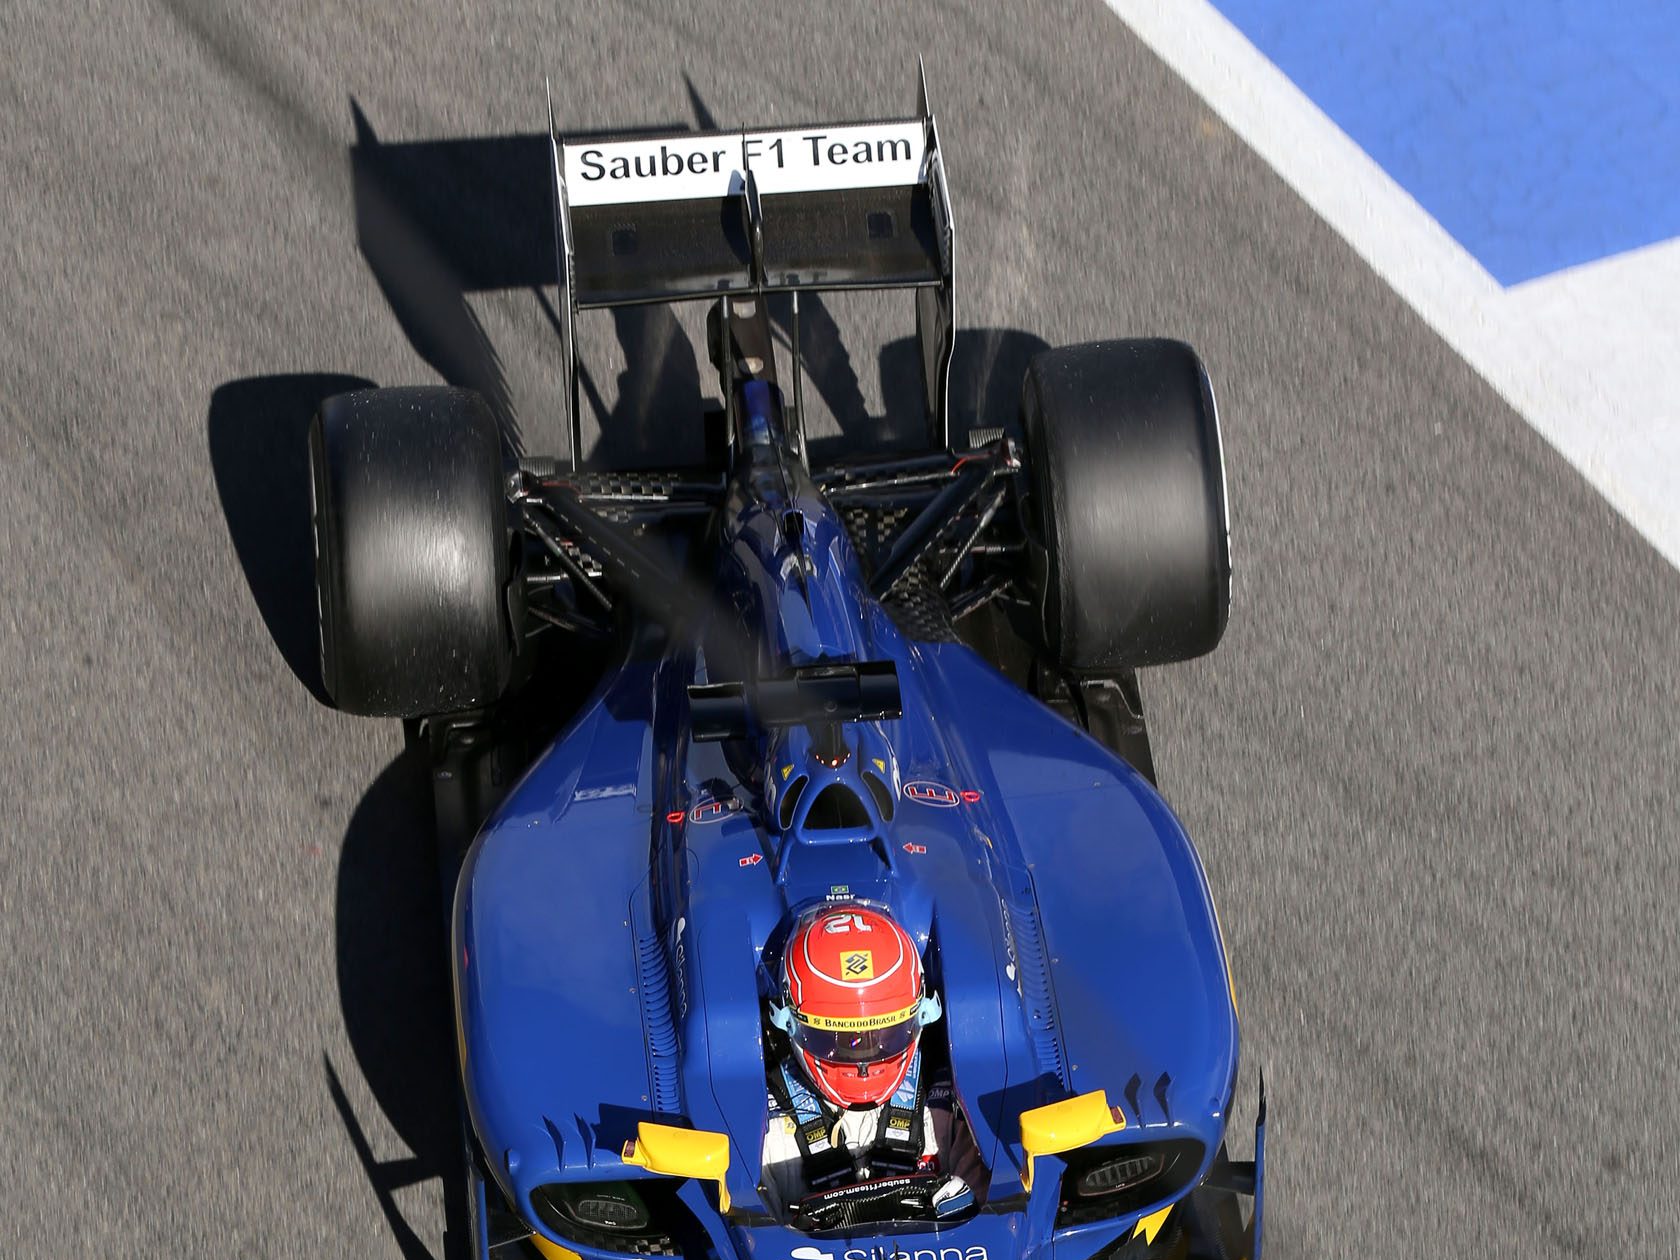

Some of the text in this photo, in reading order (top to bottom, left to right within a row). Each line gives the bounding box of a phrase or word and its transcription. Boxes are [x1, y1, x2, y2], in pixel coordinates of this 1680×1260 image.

[579, 135, 912, 181] Sauber F1 Team
[824, 914, 873, 934] 12
[889, 1118, 911, 1128] OMP
[806, 1128, 828, 1141] OMP
[824, 1178, 911, 1200] sauberf1team.com
